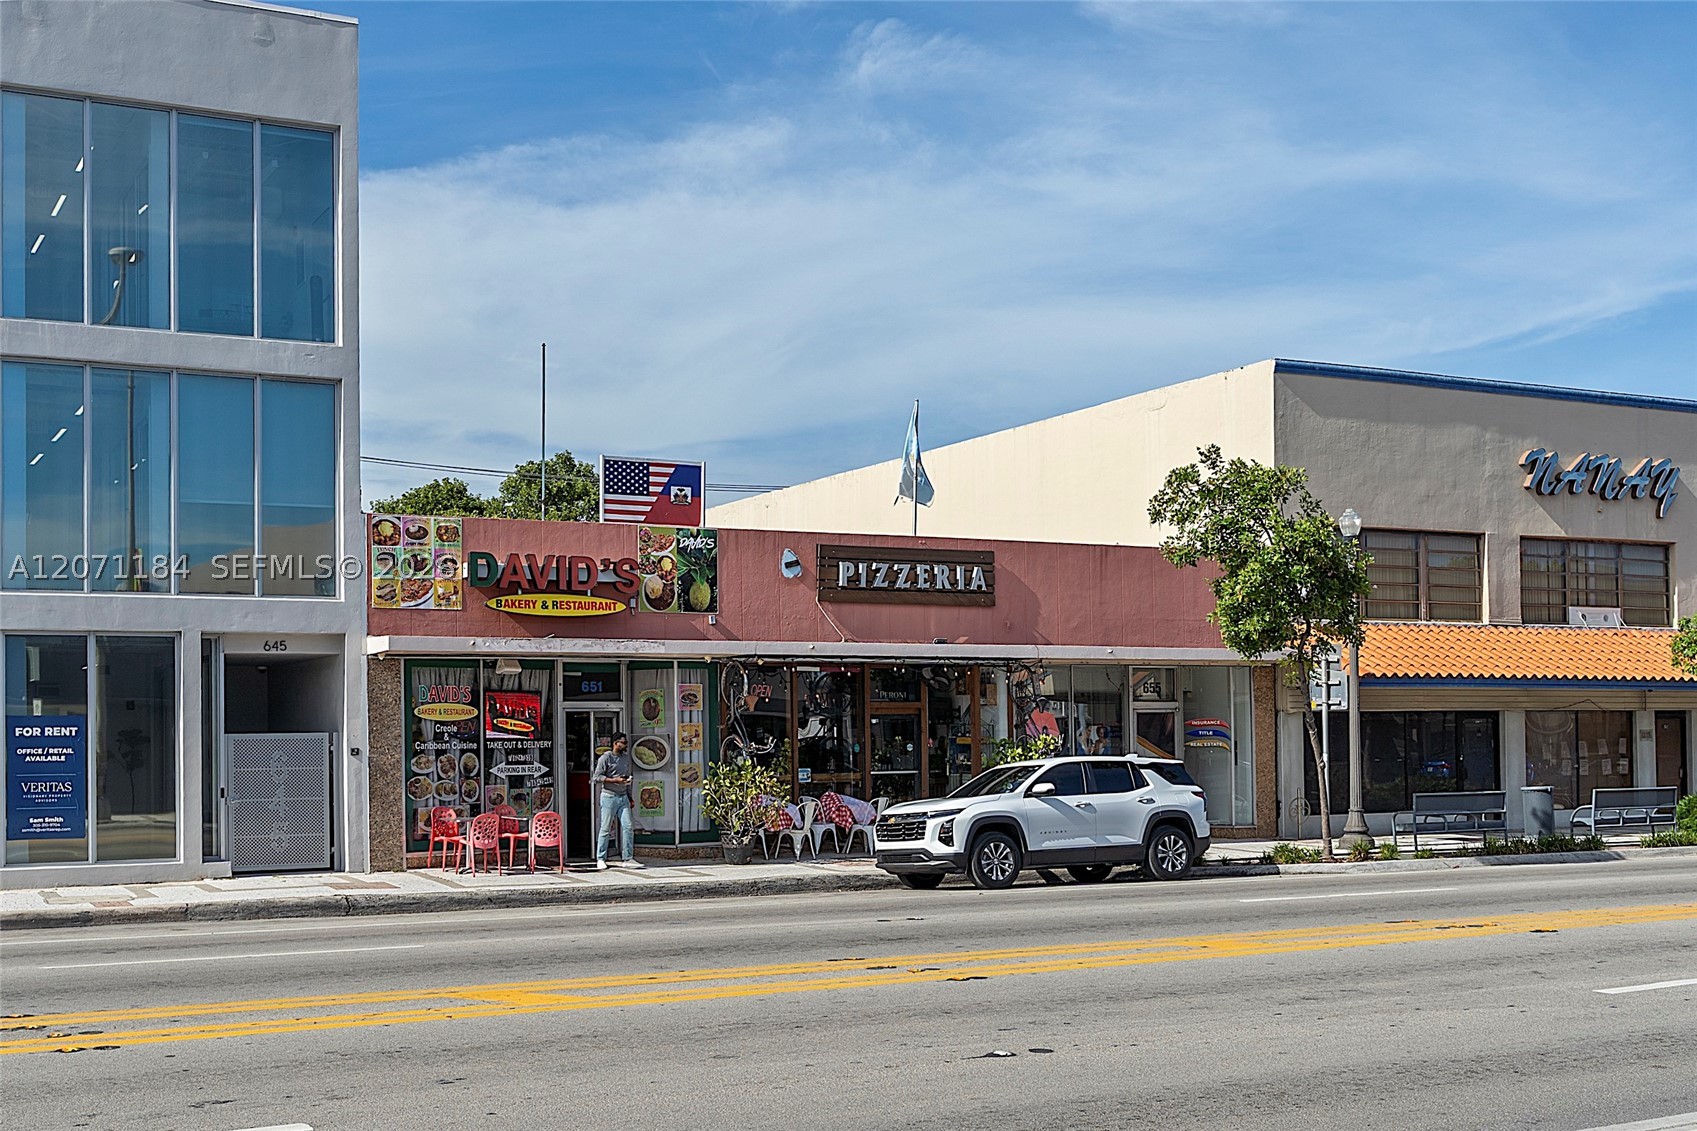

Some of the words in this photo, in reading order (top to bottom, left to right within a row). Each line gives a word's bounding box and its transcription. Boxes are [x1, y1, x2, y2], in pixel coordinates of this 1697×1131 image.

[1519, 448, 1680, 518] NANAY
[679, 535, 715, 553] DAVID'S
[468, 551, 641, 594] DAVID'S
[838, 561, 987, 591] PIZZERIA
[495, 599, 538, 610] BAKERY
[541, 600, 549, 610] &
[552, 600, 618, 612] RESTAURANT
[263, 640, 287, 652] 645
[581, 680, 603, 692] 651
[751, 684, 772, 697] OPEN
[1143, 681, 1161, 694] 655
[418, 684, 472, 703] DAVID'S
[879, 690, 907, 699] PERONI
[417, 708, 437, 716] BAKERY
[443, 708, 475, 716] RESTAURANT
[15, 727, 41, 737] FOR
[44, 726, 78, 737] RENT
[435, 724, 458, 733] Creole
[443, 732, 449, 741] &
[415, 741, 450, 750] Caribbean
[451, 741, 477, 750] Cuisine
[486, 741, 503, 749] TAKE
[503, 741, 517, 749] OUT
[517, 741, 522, 749] &
[523, 741, 552, 749] DELIVERY
[496, 766, 520, 774] PARKING
[521, 766, 527, 774] IN
[21, 781, 73, 793] VERITAS
